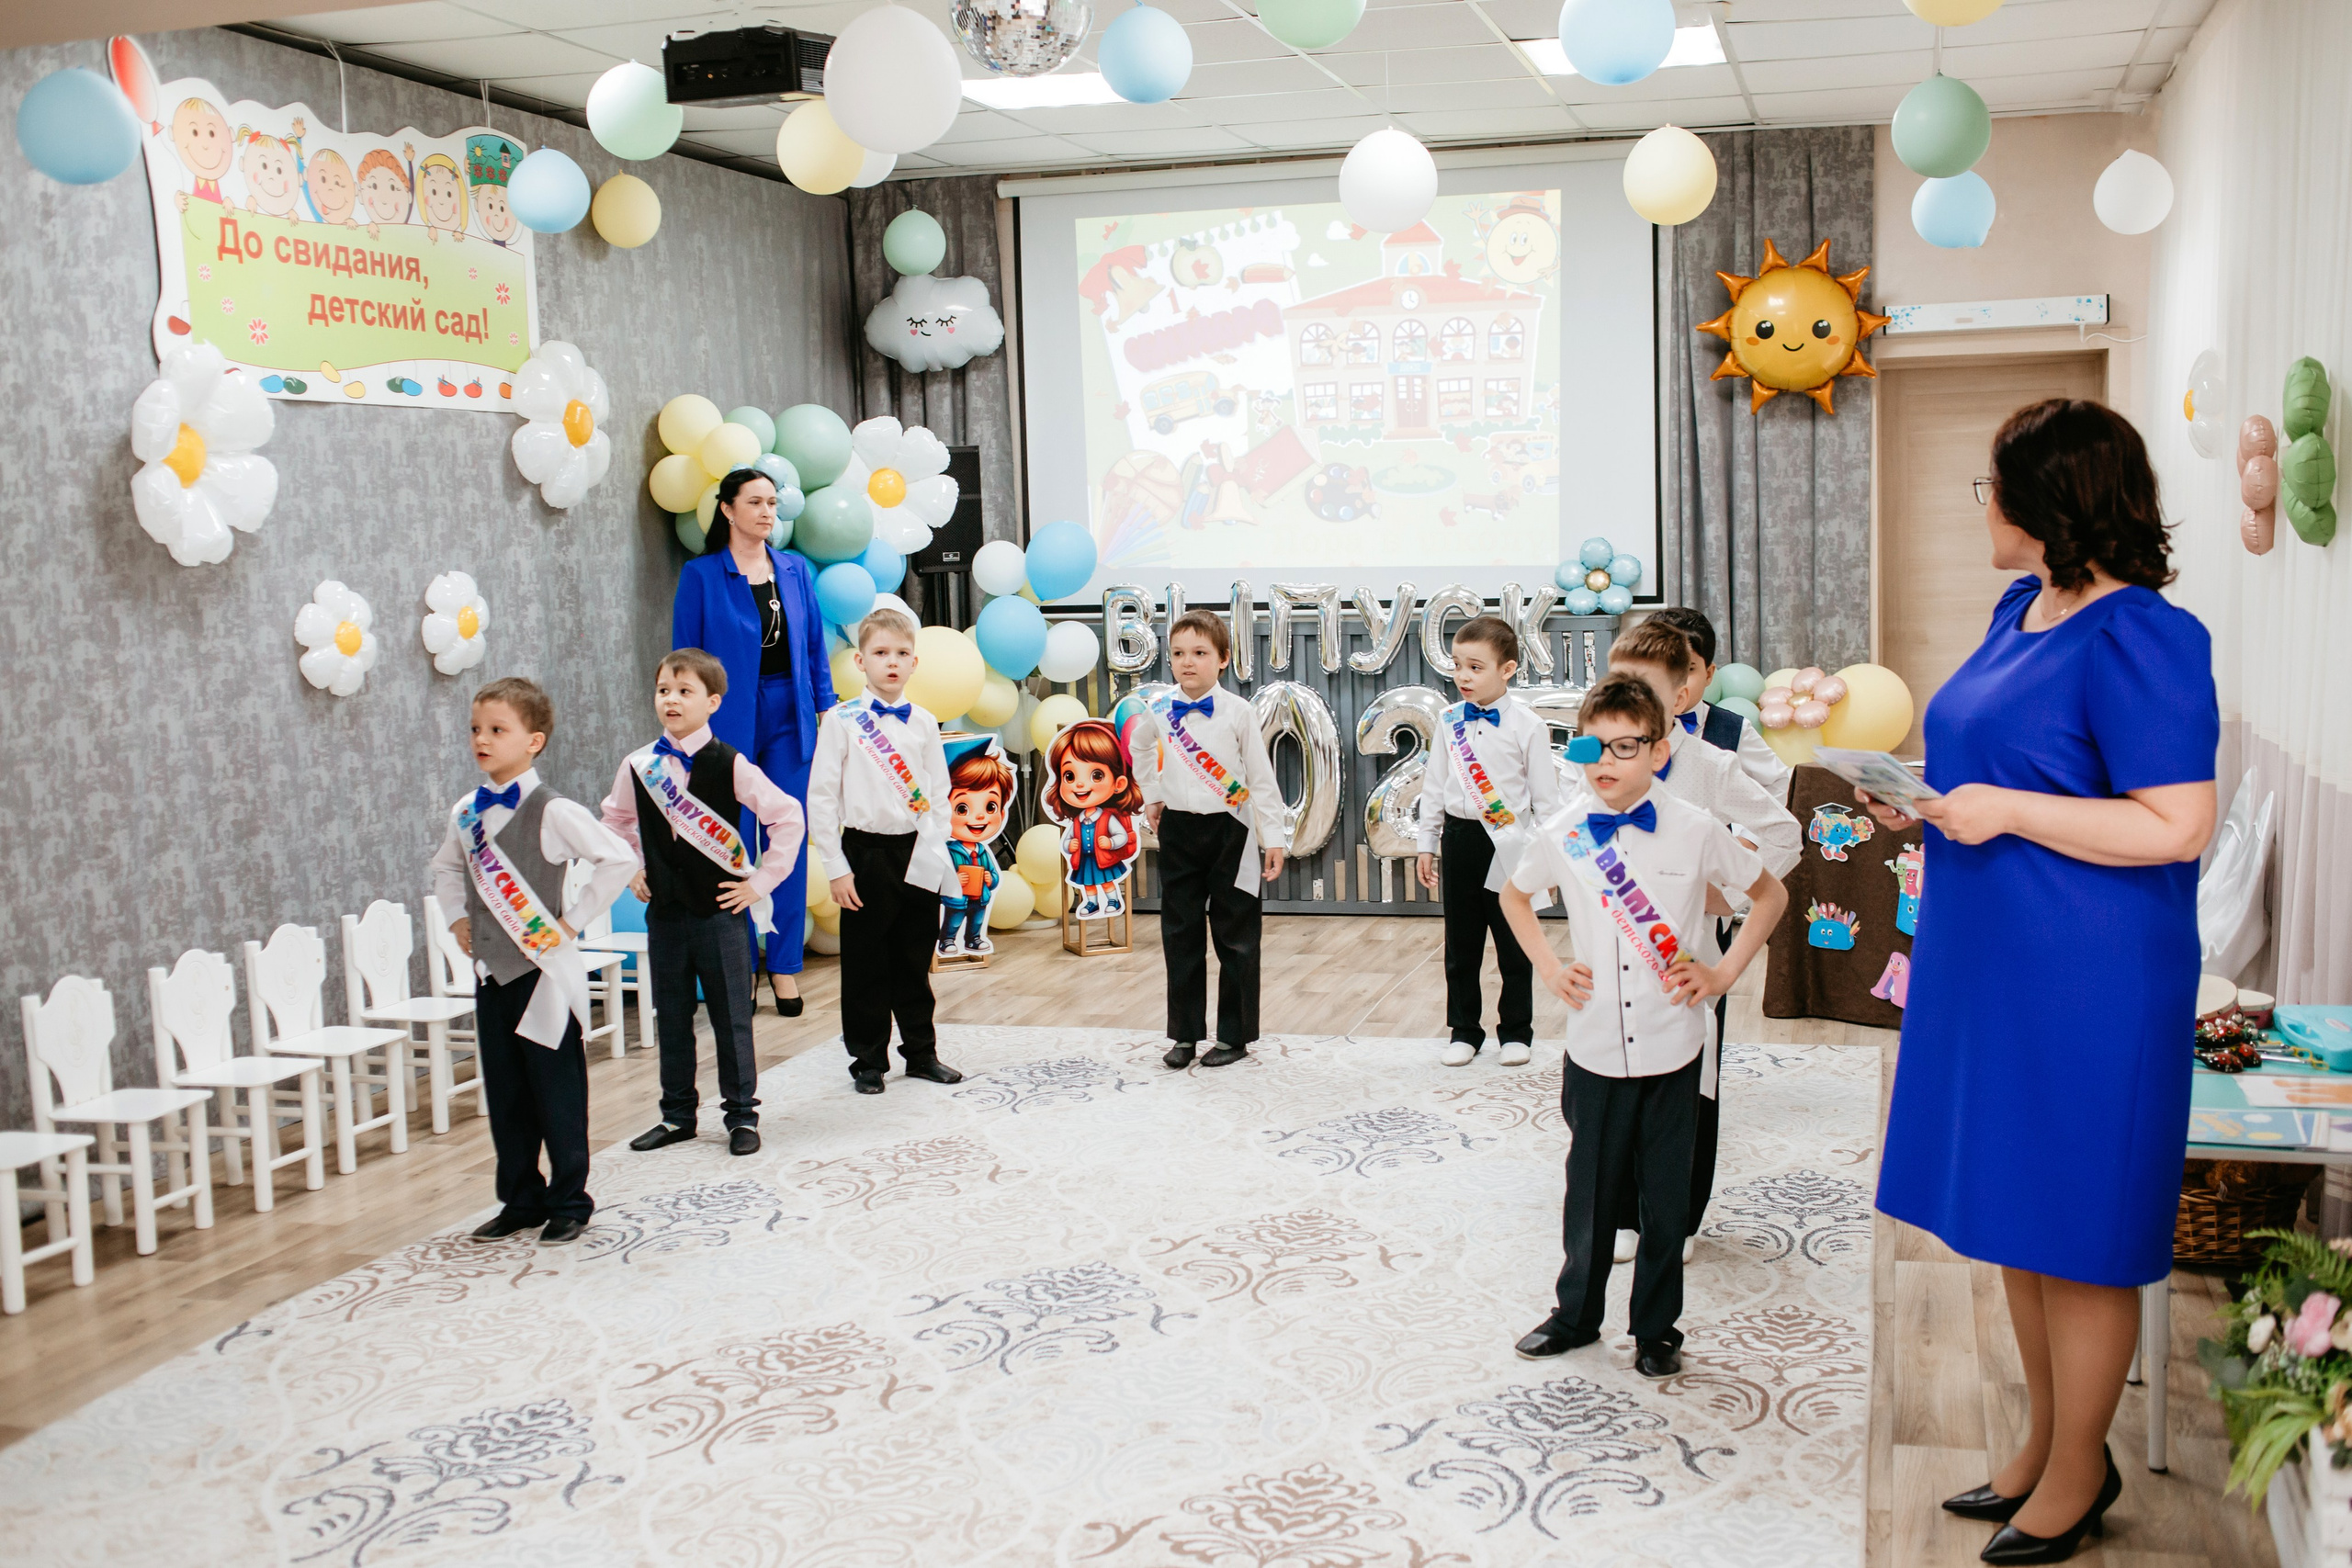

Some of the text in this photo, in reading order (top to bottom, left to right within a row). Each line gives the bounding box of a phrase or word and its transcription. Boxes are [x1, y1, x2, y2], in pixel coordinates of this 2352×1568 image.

[216, 216, 430, 290] До свидания,
[307, 293, 490, 344] детский сад!
[1166, 288, 1183, 314] 1
[855, 710, 922, 802] ВЫПУСКНИК
[865, 744, 910, 799] детского сада
[1167, 709, 1242, 796] ВЫПУСКНИК
[1172, 742, 1225, 797] детского сада
[1453, 719, 1506, 814] ВЫПУСКНИК
[1453, 752, 1485, 810] детского сада
[661, 776, 742, 858] ВЫПУСКНИК
[671, 812, 729, 862] детского сада
[470, 818, 546, 934] ВЫПУСКНИК
[471, 863, 521, 933] детского сада
[1611, 907, 1660, 971] детского
